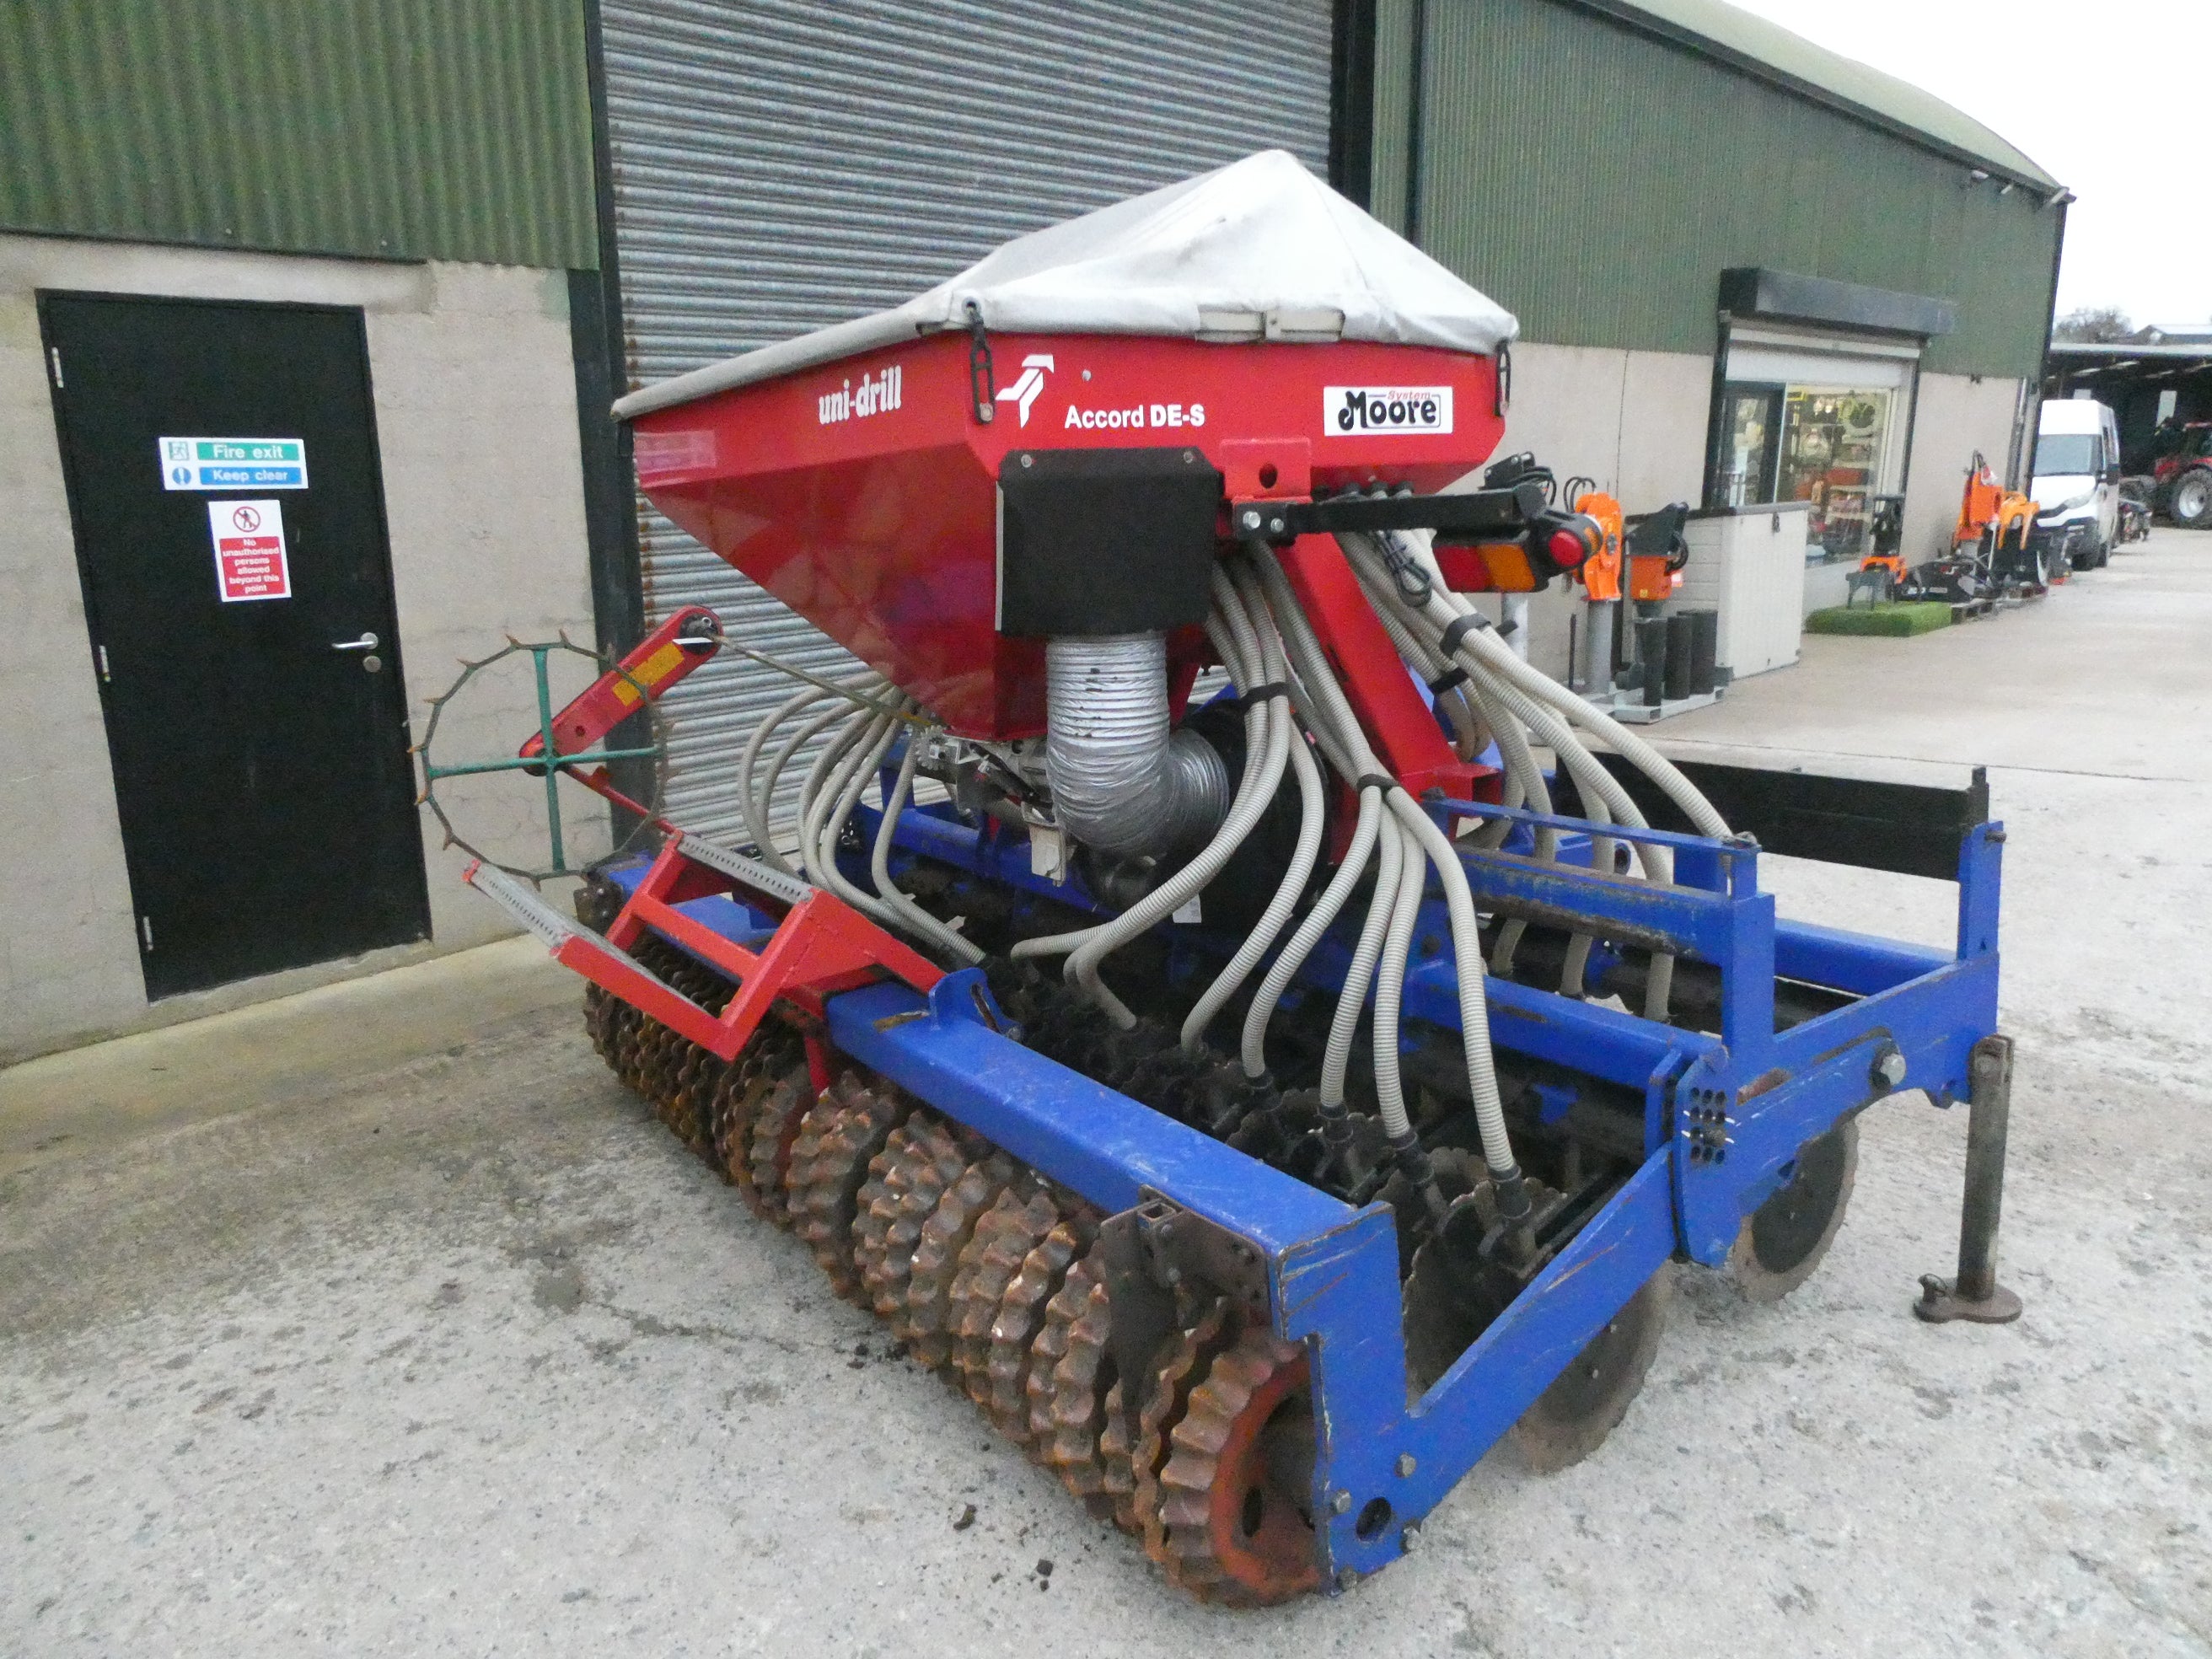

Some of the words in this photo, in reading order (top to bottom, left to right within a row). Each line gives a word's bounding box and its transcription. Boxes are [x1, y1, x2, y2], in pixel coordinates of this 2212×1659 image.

[819, 364, 902, 425] uni-drill
[1387, 390, 1431, 400] System
[1064, 404, 1145, 429] Accord
[1150, 403, 1205, 427] DE-S
[1338, 390, 1436, 431] Moore
[213, 445, 245, 459] Fire
[253, 446, 283, 459] exit
[212, 470, 250, 482] Keep
[256, 470, 288, 481] clear
[223, 547, 279, 556] unauthorised
[234, 557, 270, 566] persons
[237, 566, 270, 575] allowed
[229, 576, 261, 585] beyond
[264, 574, 279, 583] this
[244, 584, 267, 593] point
